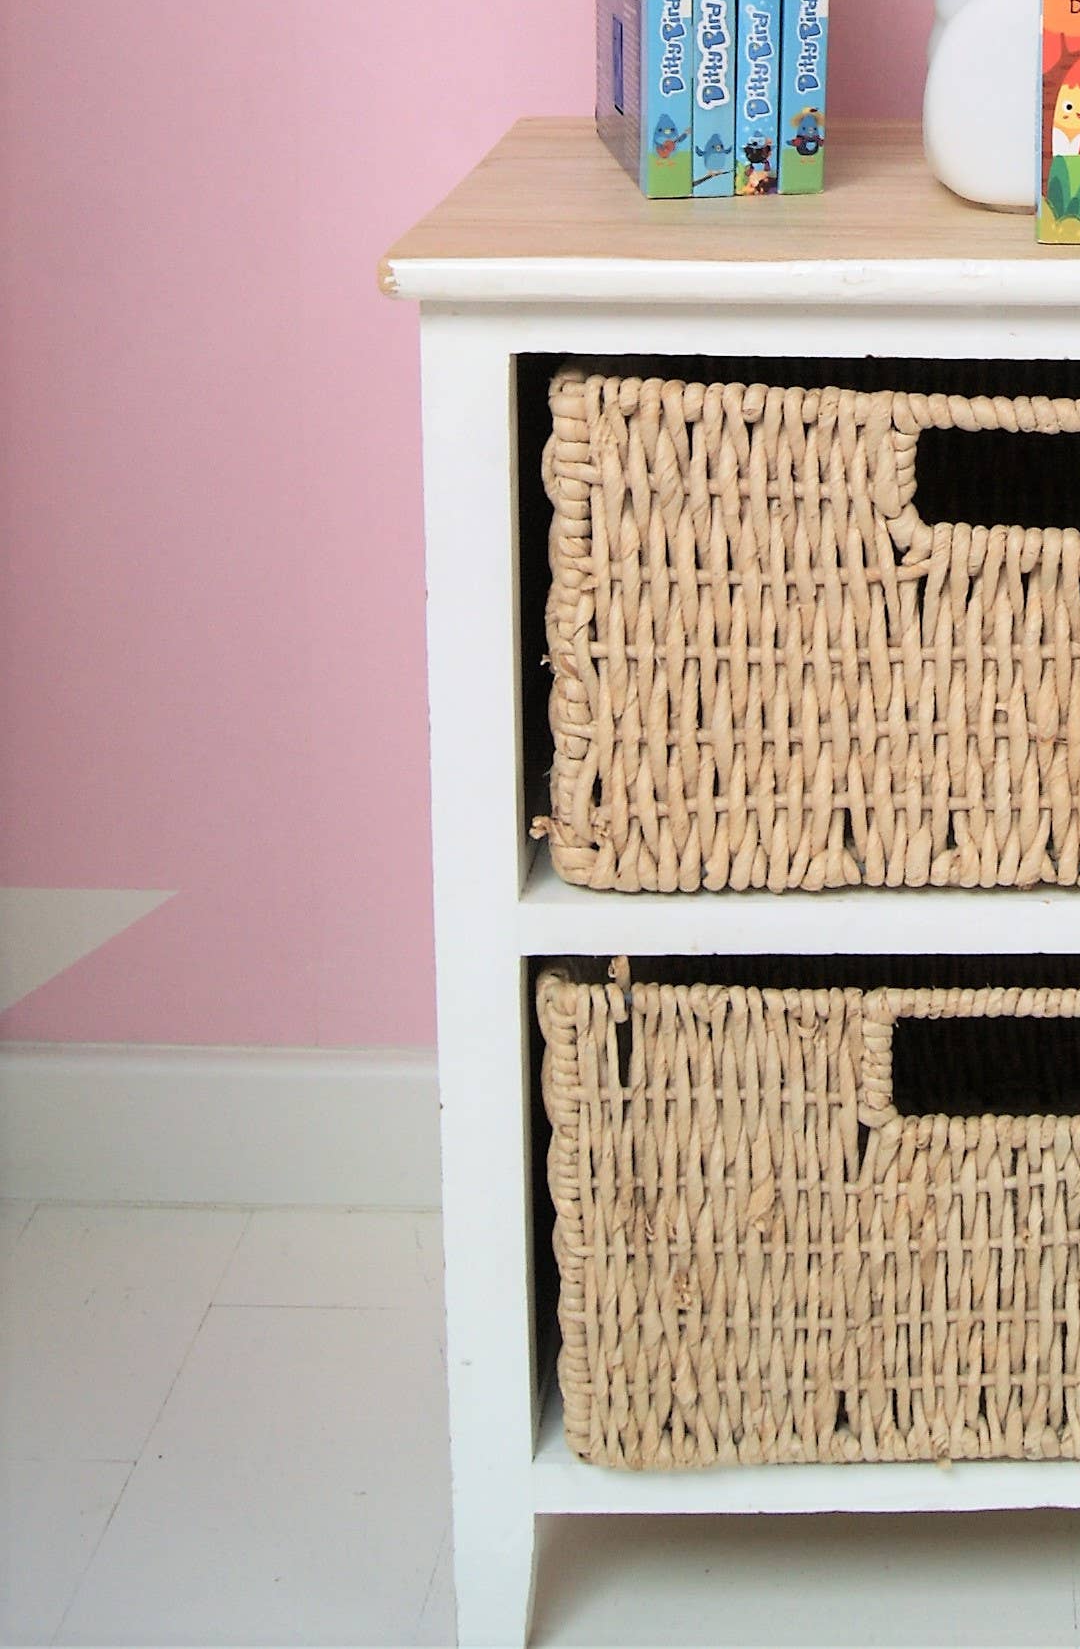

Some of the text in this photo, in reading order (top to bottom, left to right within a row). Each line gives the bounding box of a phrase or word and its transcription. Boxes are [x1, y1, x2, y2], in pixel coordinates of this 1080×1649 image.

[662, 43, 685, 95] Ditty
[702, 3, 726, 105] Ditty Bird
[746, 12, 772, 119] Ditty Bird
[797, 42, 819, 92] Ditty
